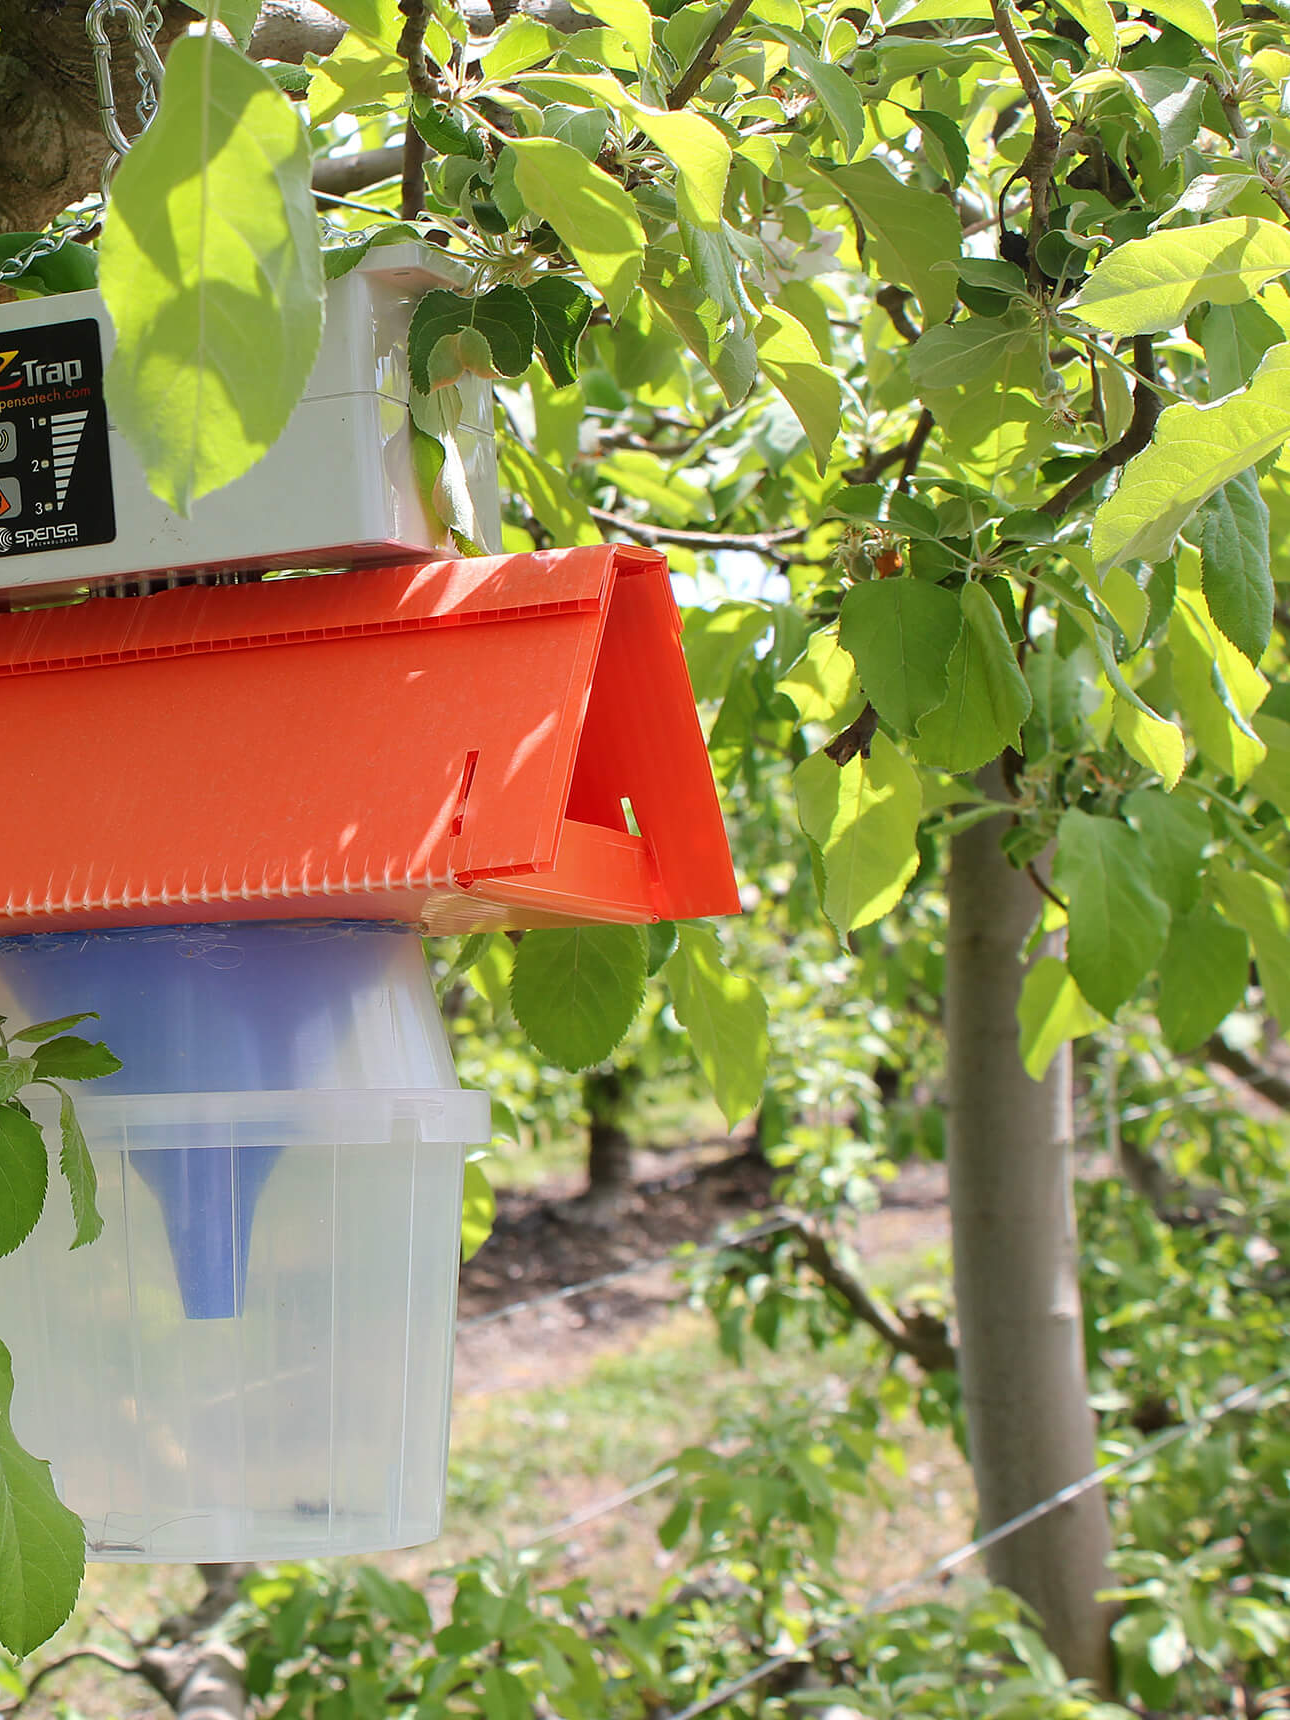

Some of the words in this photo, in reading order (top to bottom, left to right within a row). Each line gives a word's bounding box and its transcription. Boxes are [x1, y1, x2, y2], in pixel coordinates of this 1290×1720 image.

[29, 417, 36, 430] 1
[31, 460, 40, 473] 2
[34, 502, 43, 515] 3
